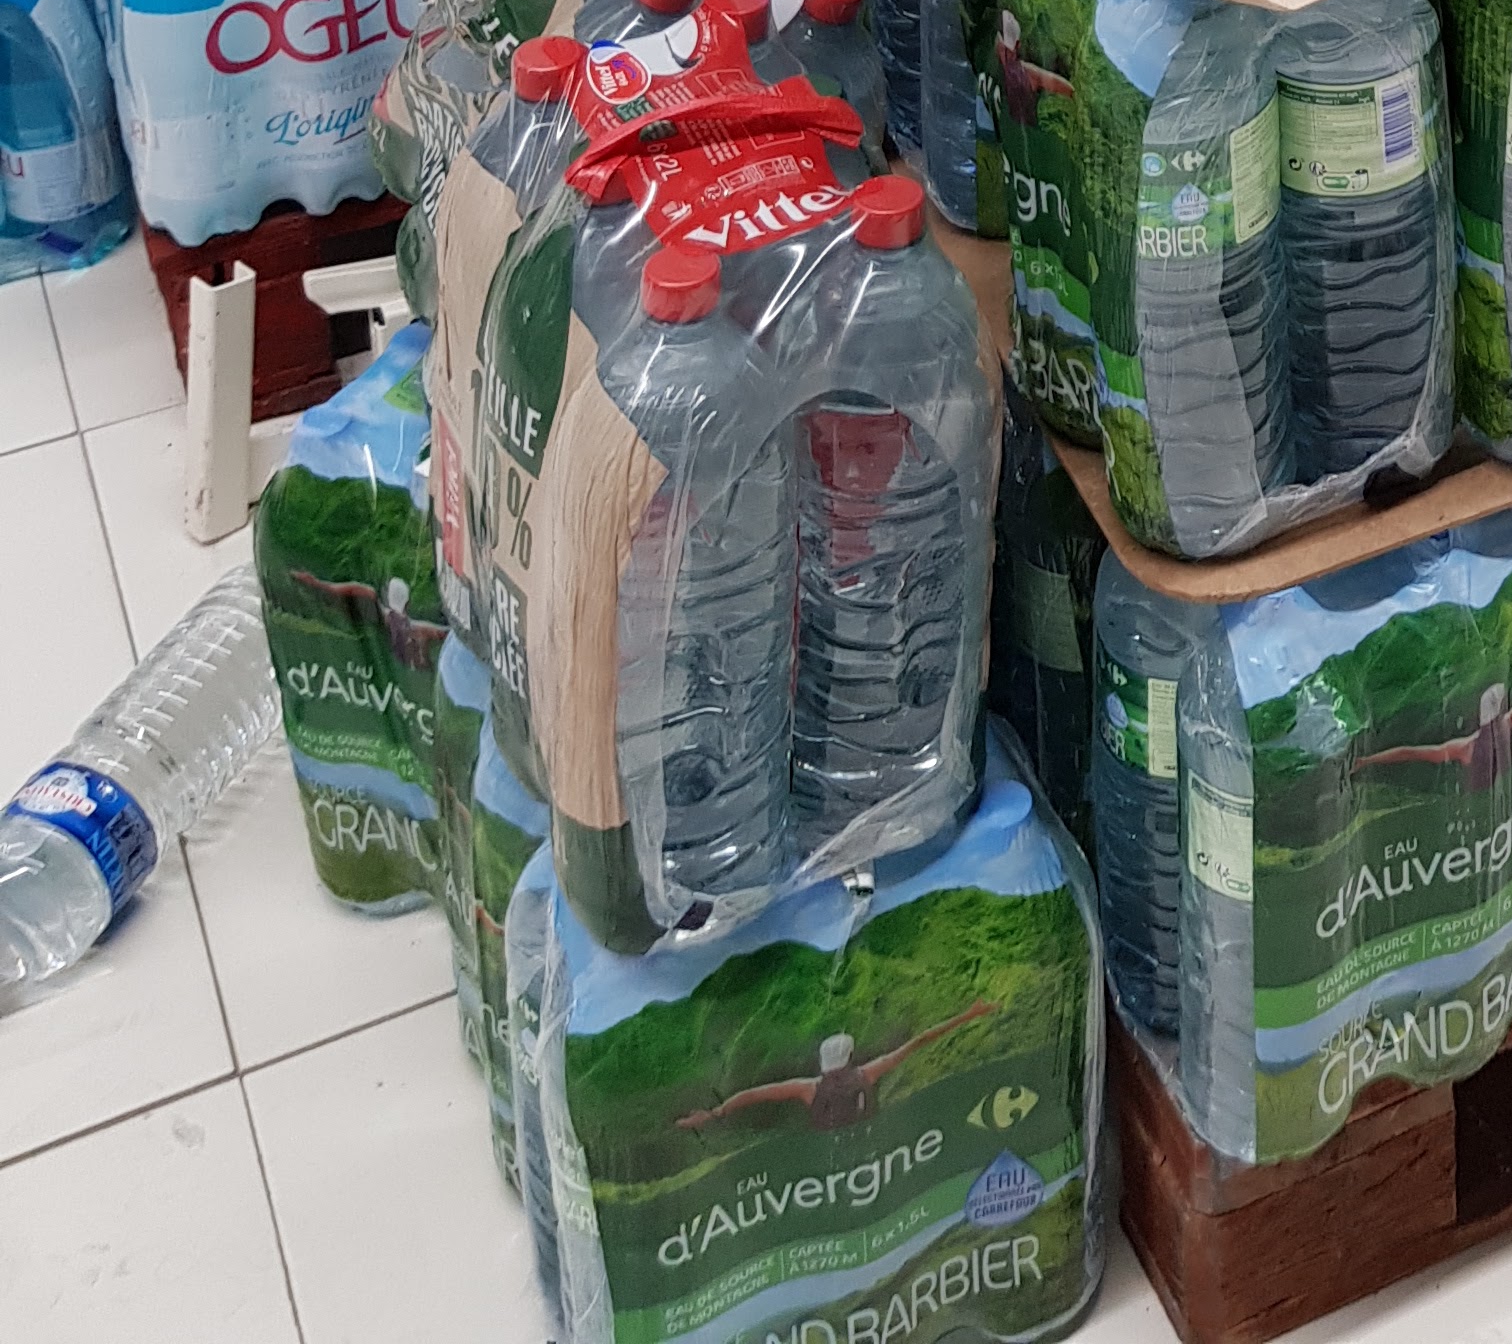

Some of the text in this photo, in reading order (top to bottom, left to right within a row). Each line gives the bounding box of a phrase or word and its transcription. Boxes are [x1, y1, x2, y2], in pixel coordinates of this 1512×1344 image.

[1384, 837, 1418, 861] EAU
[1316, 975, 1343, 995] EAU
[1363, 931, 1417, 963] SOURCE
[1445, 927, 1481, 949] 1270
[1317, 949, 1410, 1010] DE MONTAGNE
[1318, 1000, 1475, 1115] GRAND
[658, 1128, 944, 1267] d'Auvergne
[737, 1171, 768, 1195] EAU
[974, 1193, 1037, 1220] CARREFOUR
[986, 1168, 1026, 1193] EAU
[789, 1239, 845, 1261] CAPTÉE
[665, 1302, 694, 1320] EAU
[718, 1255, 775, 1295] SOURCE
[667, 1274, 770, 1335] DE MONTAGNE
[846, 1235, 1042, 1344] BARBIER
